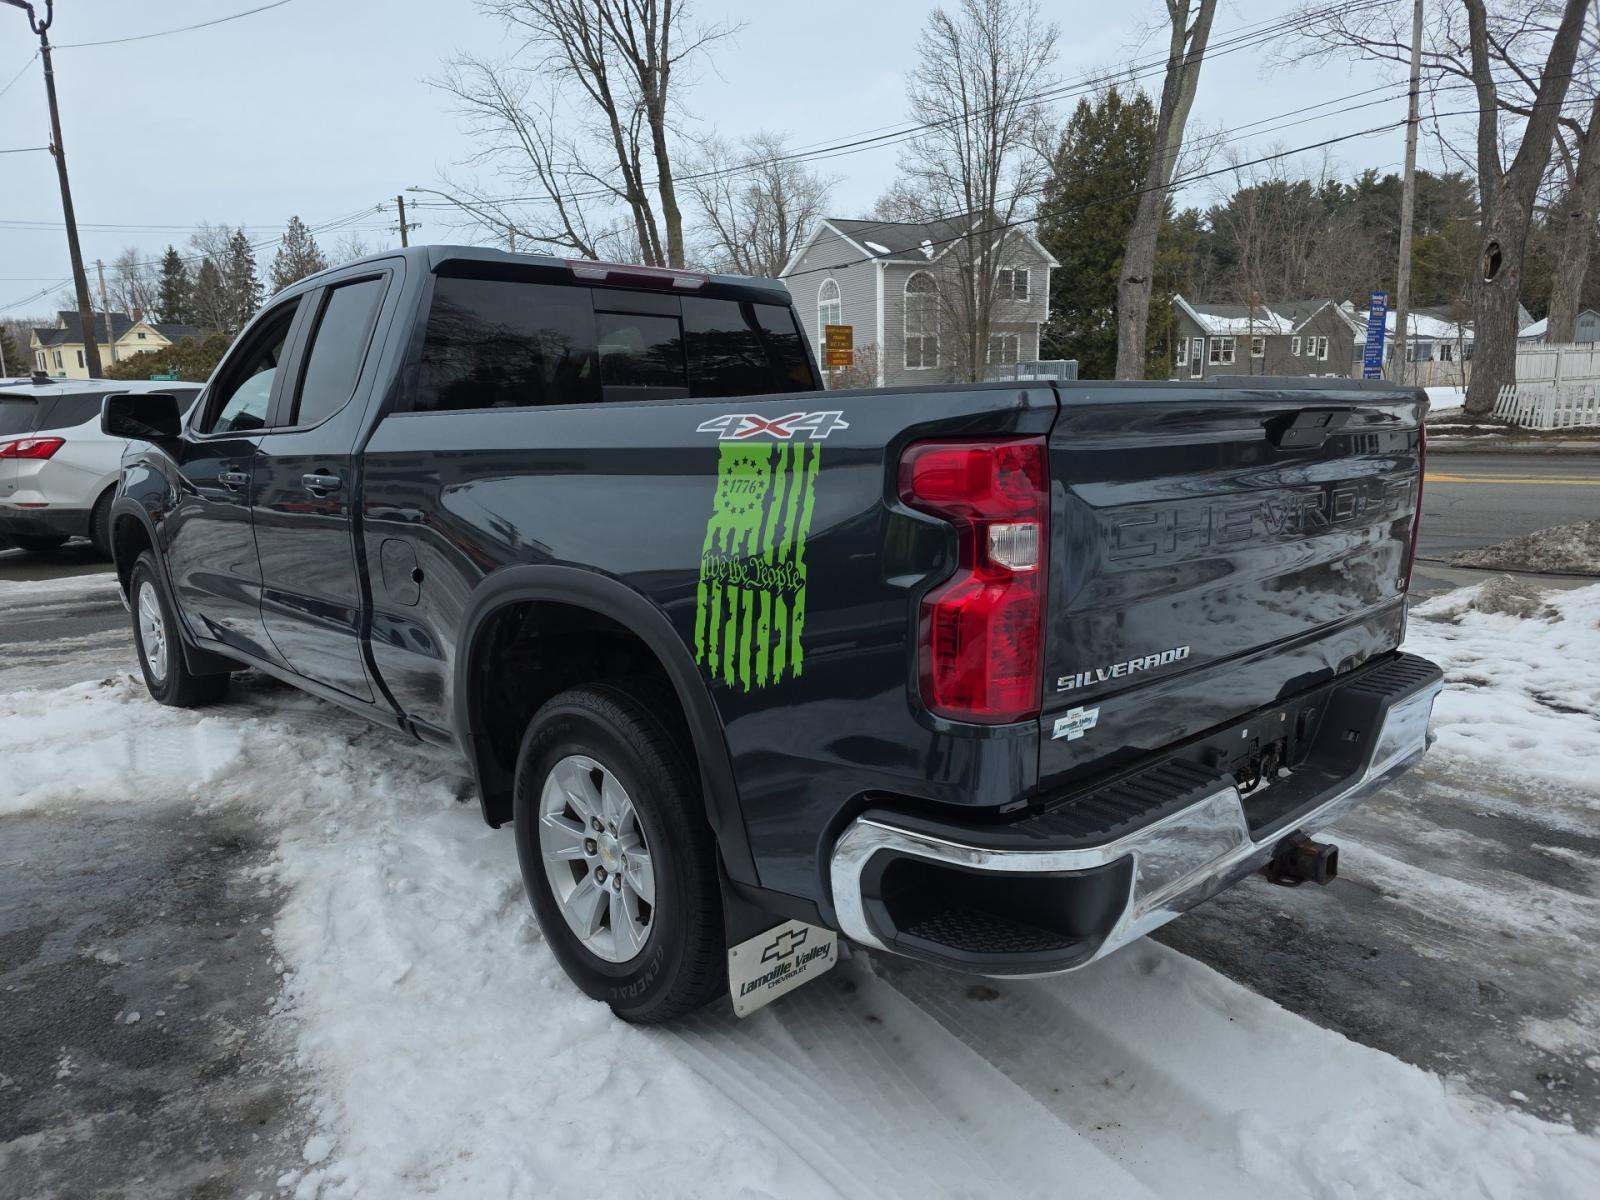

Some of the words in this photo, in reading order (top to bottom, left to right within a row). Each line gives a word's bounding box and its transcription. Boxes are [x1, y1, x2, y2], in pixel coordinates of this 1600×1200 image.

[728, 478, 757, 494] 1776
[704, 550, 728, 581] We
[727, 554, 750, 584] the
[745, 556, 804, 595] People
[1057, 645, 1190, 693] SILVERADO
[609, 945, 665, 1000] GENERAL
[740, 961, 792, 998] Lamoille
[795, 942, 831, 969] Valley
[767, 964, 808, 990] CHEVROLET
